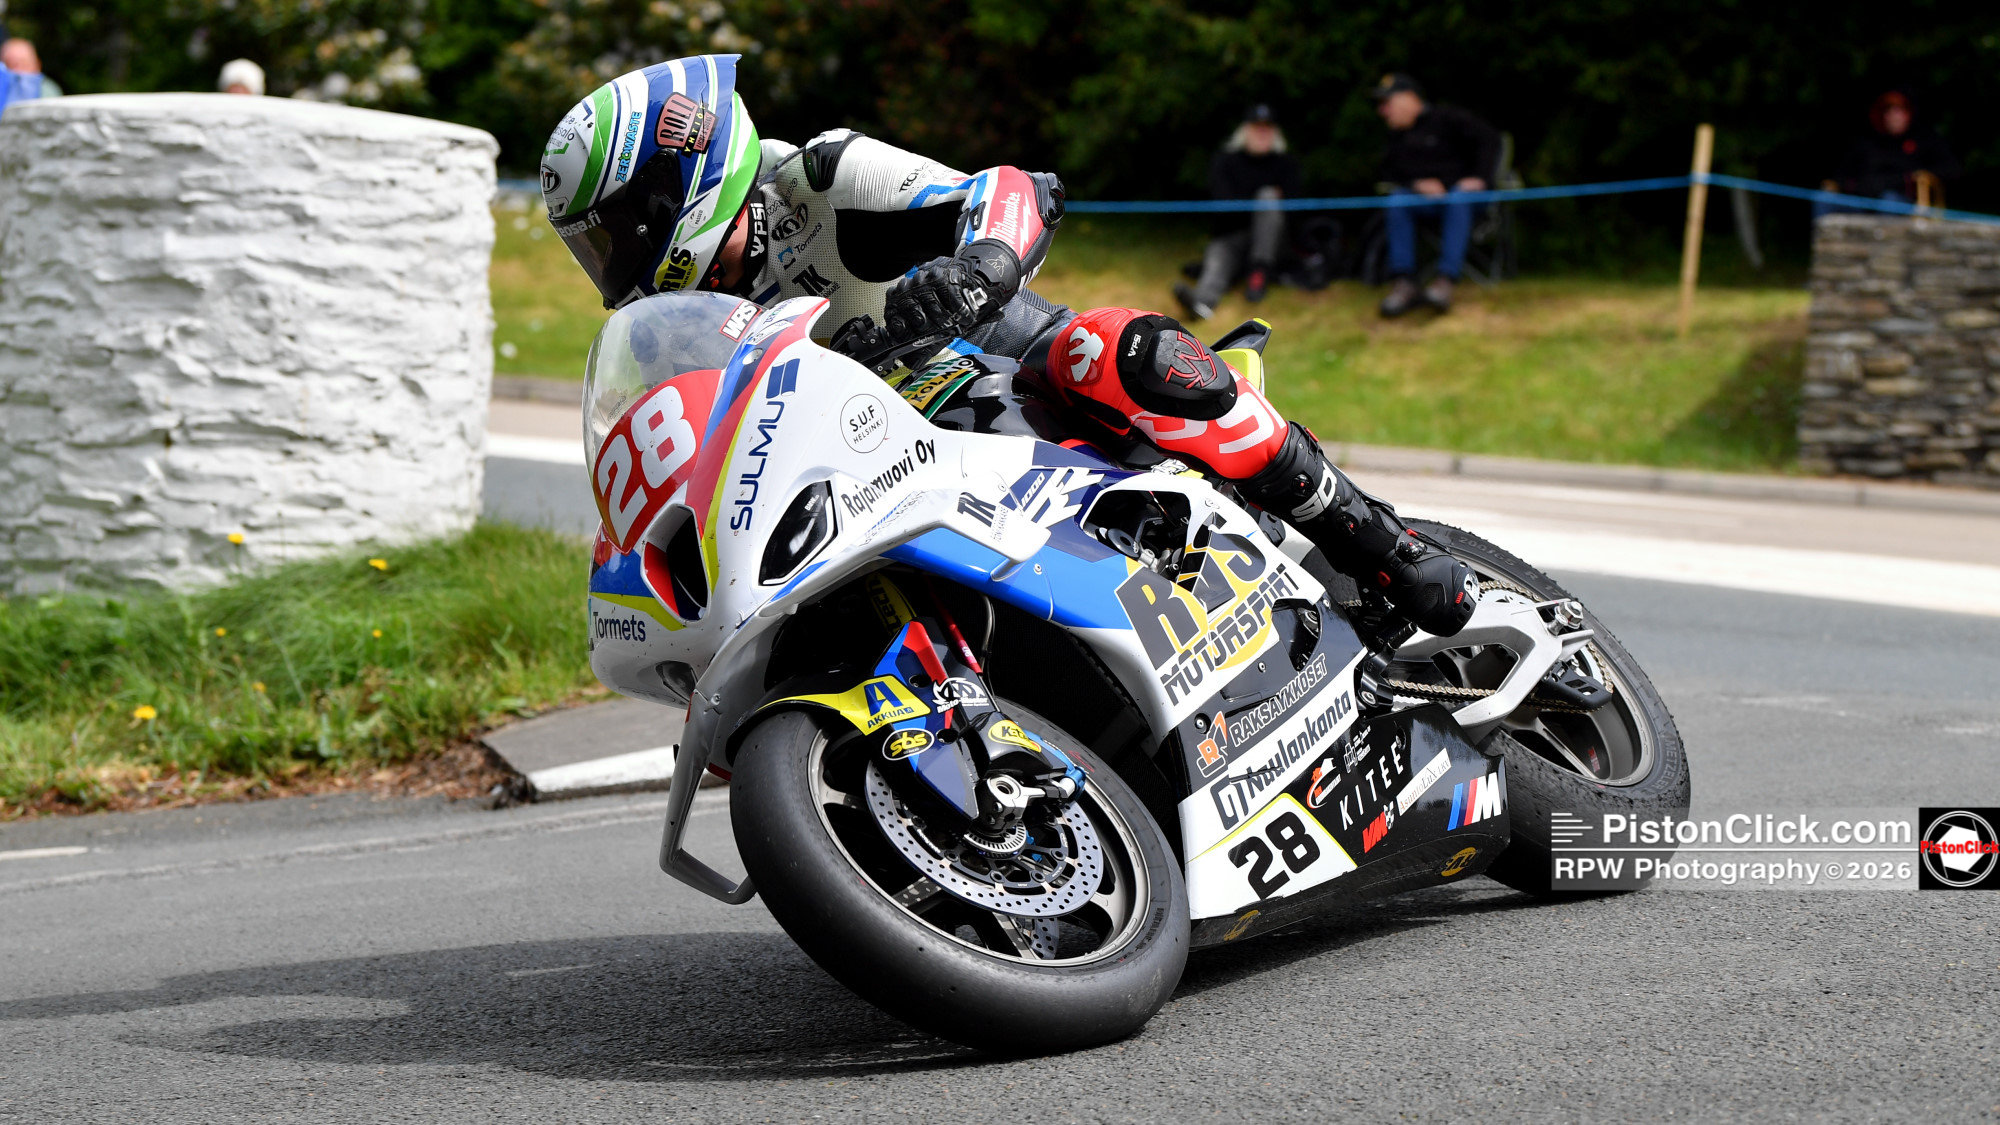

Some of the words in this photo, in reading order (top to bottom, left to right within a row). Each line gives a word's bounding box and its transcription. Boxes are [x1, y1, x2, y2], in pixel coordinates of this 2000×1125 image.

[615, 111, 642, 183] ZEROWASTE
[660, 99, 696, 142] ROLL
[597, 385, 697, 547] 28
[730, 401, 785, 531] SULMU
[853, 418, 884, 444] HELSINKI
[841, 448, 914, 518] Rajamuovi
[915, 438, 936, 464] Oy
[593, 611, 646, 642] Tormets
[1115, 512, 1266, 671] RVS
[1160, 563, 1299, 707] MOTORSPORT
[890, 731, 927, 757] sbs
[1340, 741, 1404, 831] KITEE
[1228, 811, 1321, 900] 28
